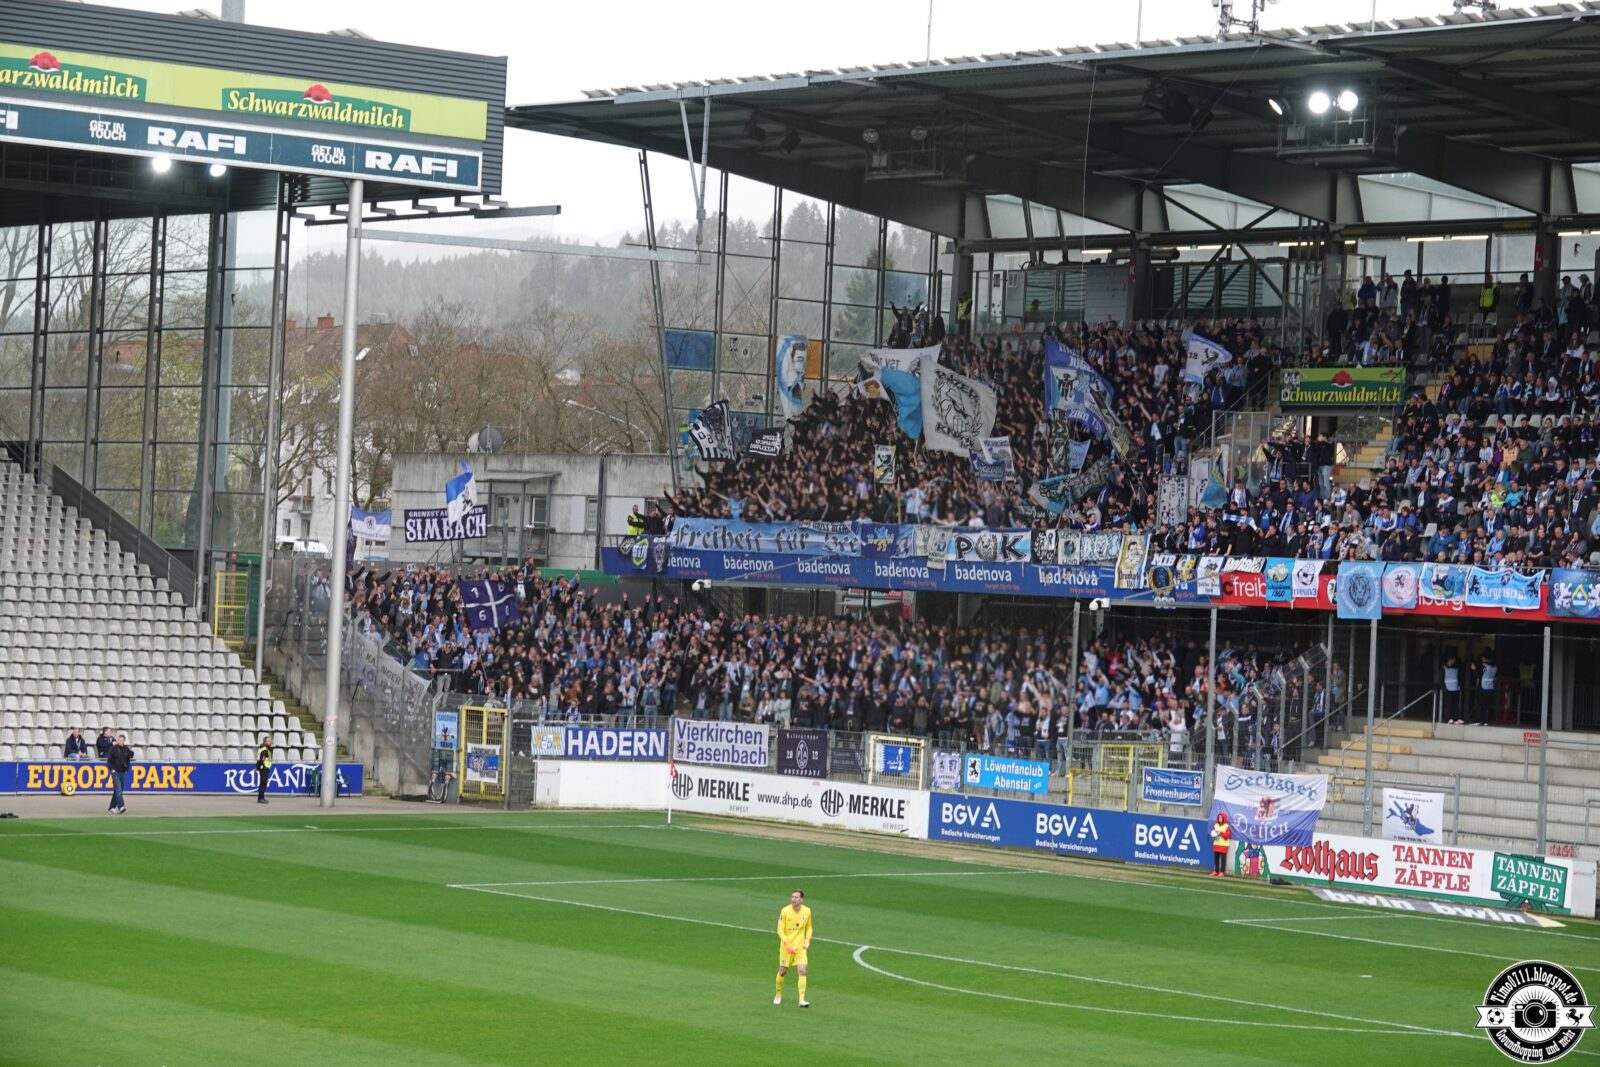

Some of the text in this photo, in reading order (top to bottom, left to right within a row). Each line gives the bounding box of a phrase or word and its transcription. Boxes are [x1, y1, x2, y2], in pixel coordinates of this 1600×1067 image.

[227, 89, 405, 129] Schwarzwaldmilch
[89, 120, 125, 132] GET IN
[90, 130, 127, 141] TOUCH
[147, 126, 247, 155] RAFI
[311, 144, 344, 157] GET IN
[312, 154, 346, 166] TOUCH
[364, 150, 458, 178] RAFI
[1289, 386, 1400, 402] chwarzwaldmilch
[406, 513, 487, 542] SIMBACH
[723, 555, 775, 572] badenova
[797, 558, 851, 575] badenova
[875, 562, 930, 579] badenova
[954, 565, 1012, 582] badenova
[567, 729, 666, 758] HADERN
[676, 719, 764, 746] Vierkirchen
[686, 742, 767, 767] Pasenbach
[131, 765, 195, 789] PARK
[984, 758, 1043, 778] Löwenfanclub
[698, 777, 750, 802] MERKLE
[994, 774, 1031, 791] Abenstal
[1145, 785, 1200, 801] Frontenhausen
[757, 791, 813, 809] www.ahp.de
[820, 789, 905, 820] AHP MERKLE
[941, 829, 1001, 843] Badische Versicherungen
[1035, 839, 1098, 854] Badische Versicherungen
[1134, 850, 1200, 866] Badische Versicherungen
[1280, 840, 1379, 882] Rothaus
[1392, 844, 1475, 870] TANNEN
[1395, 865, 1471, 892] ZÄPFLE
[1496, 855, 1564, 885] TANNEN
[1496, 874, 1560, 902] ZÄPFLE
[1323, 888, 1417, 911] bwin
[1429, 902, 1527, 924] bwin
